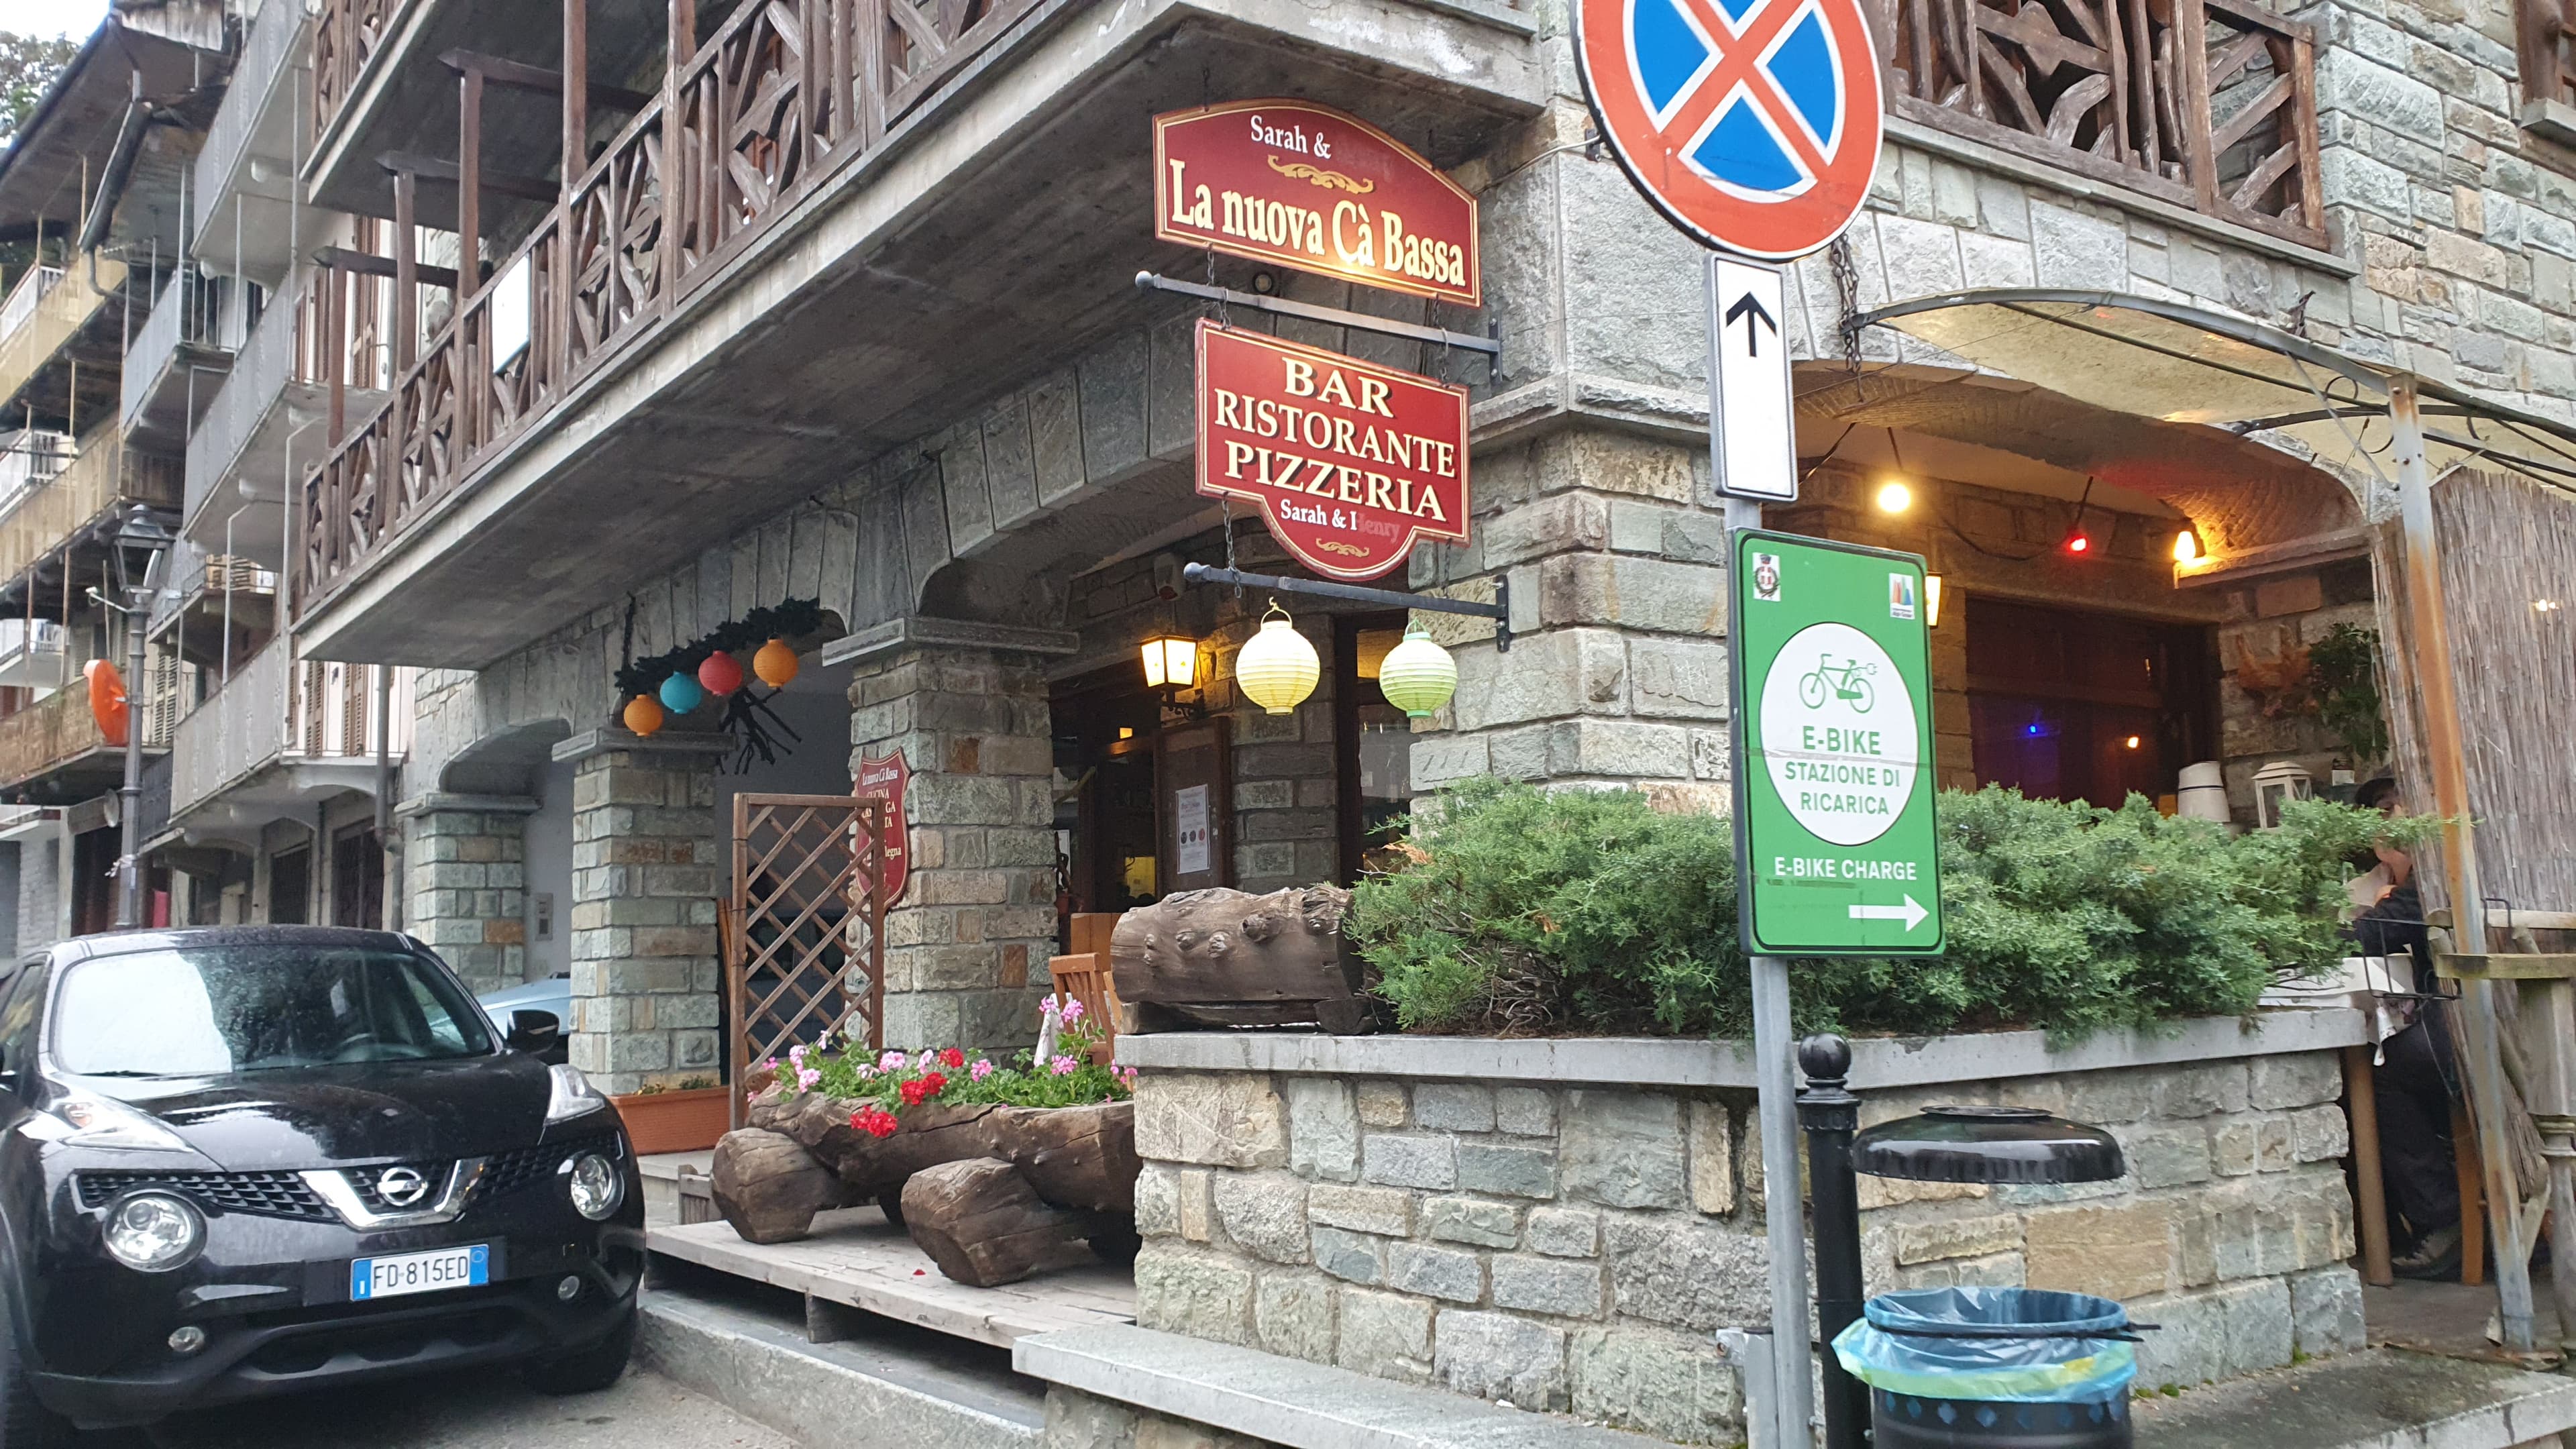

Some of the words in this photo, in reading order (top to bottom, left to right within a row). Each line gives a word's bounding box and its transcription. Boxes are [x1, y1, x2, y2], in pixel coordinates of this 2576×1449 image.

[1250, 115, 1308, 154] Sarah
[1313, 133, 1332, 159] &
[1169, 158, 1214, 230] La
[1222, 189, 1325, 256] nuova
[1332, 200, 1375, 267] Cà
[1381, 211, 1466, 287] Bassa
[1282, 356, 1394, 417] BAR
[1214, 388, 1455, 478] RISTORANTE
[1224, 440, 1446, 522] PIZZERIA
[1281, 498, 1328, 526] Sarah
[1332, 508, 1347, 529] &
[1803, 726, 1880, 755] E-BIKE
[1785, 761, 1877, 786] STAZIONE
[1883, 768, 1900, 787] DI
[1801, 792, 1889, 816] RICARICA
[1774, 857, 1836, 877] E-BIKE
[1841, 859, 1917, 881] CHARGE
